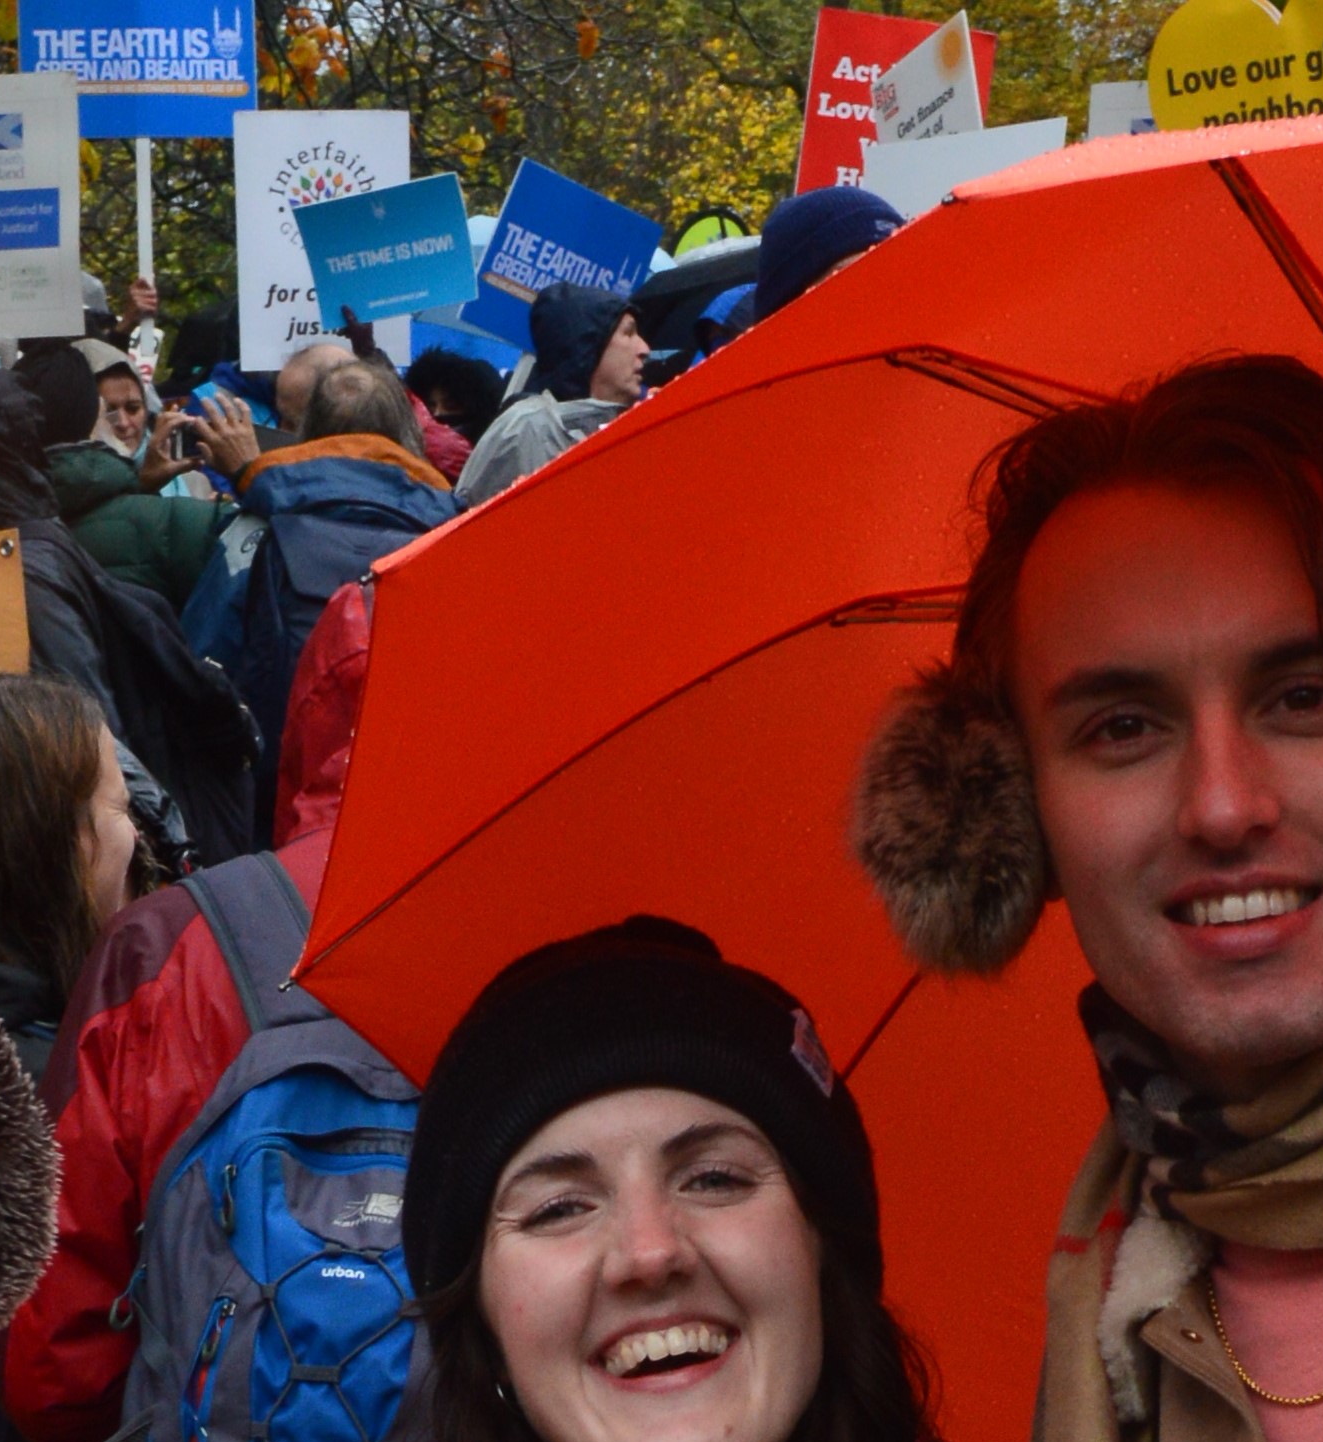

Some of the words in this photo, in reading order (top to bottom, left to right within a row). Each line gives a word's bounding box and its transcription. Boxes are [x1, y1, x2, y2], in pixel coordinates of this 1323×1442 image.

[33, 28, 87, 59] THE
[91, 27, 177, 59] EARTH
[183, 28, 210, 59] IS
[35, 59, 98, 81] GREEN
[100, 59, 142, 80] AND
[144, 59, 245, 81] BEAUTIFUL
[832, 56, 882, 83] Act
[1167, 65, 1237, 97] Love
[1245, 53, 1296, 82] our
[897, 116, 916, 139] Get
[917, 86, 955, 124] finance
[268, 140, 376, 197] Interfaith
[39, 202, 54, 216] for
[325, 255, 358, 275] THE
[357, 247, 394, 269] TIME
[395, 242, 411, 261] IS
[412, 234, 455, 257] NOW!
[491, 252, 538, 288] GREEN
[502, 222, 542, 264] THE
[536, 240, 598, 288] EARTH
[596, 267, 614, 291] IS
[264, 283, 301, 309] for
[322, 1265, 365, 1279] urban
